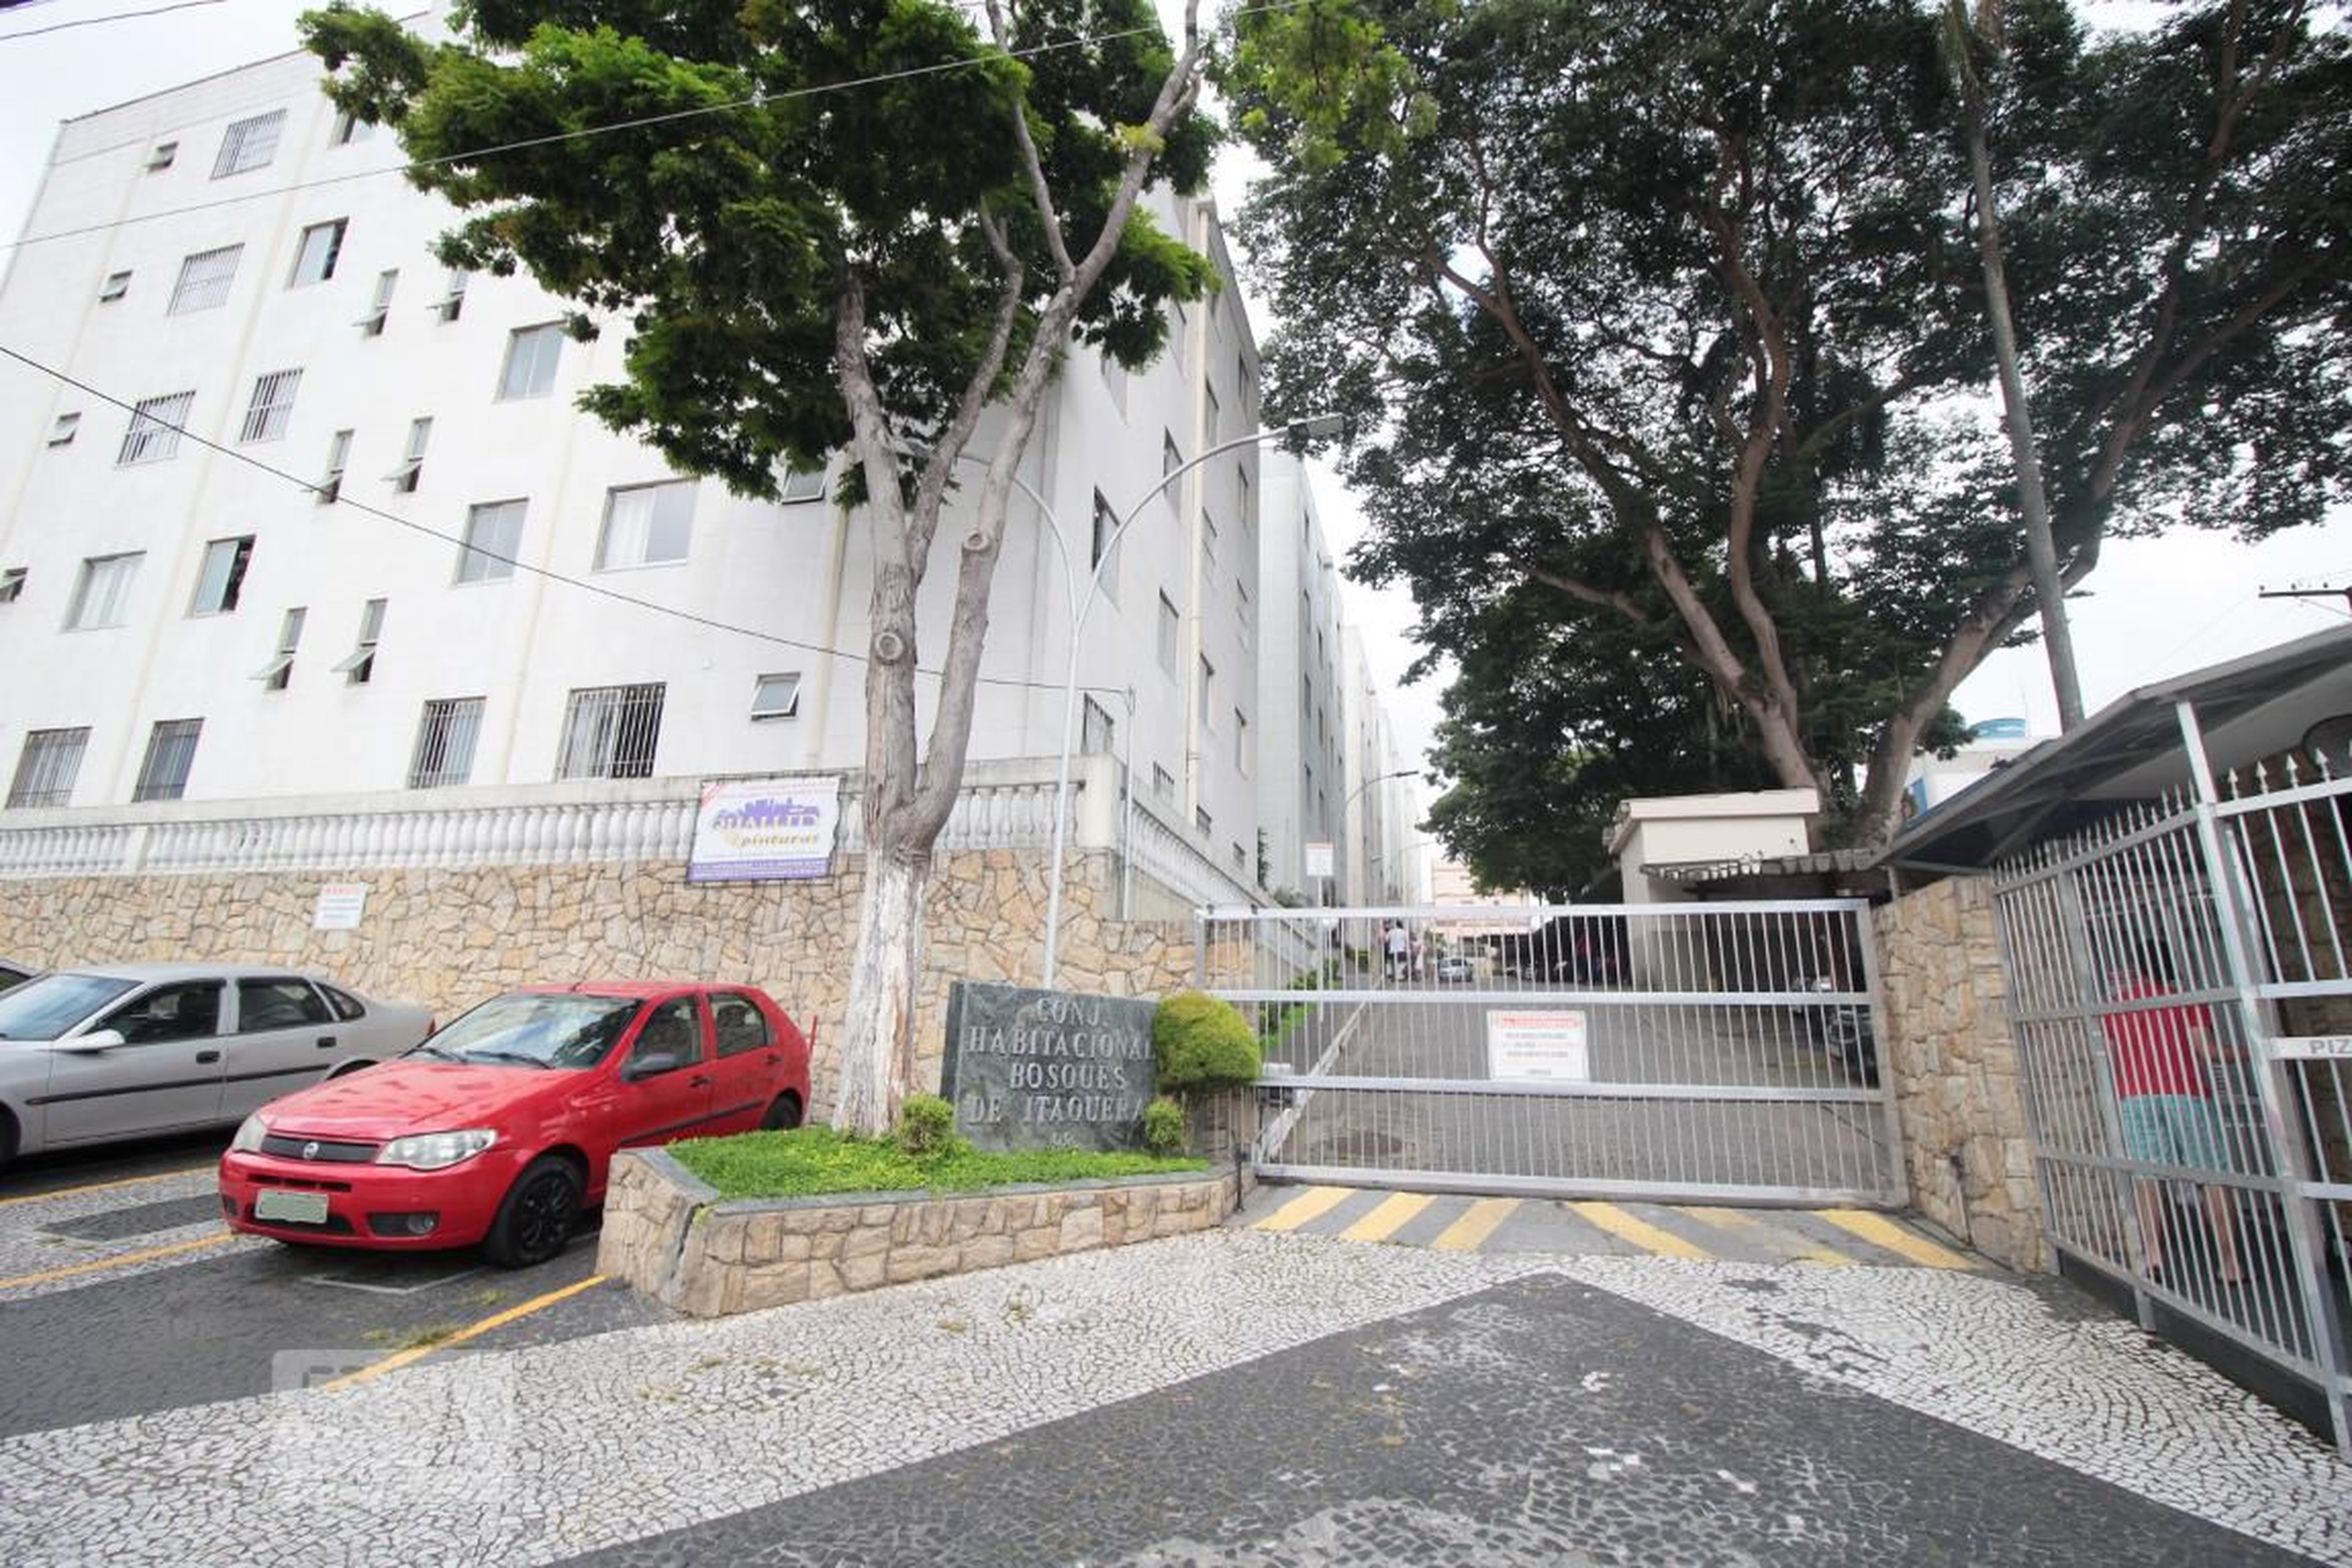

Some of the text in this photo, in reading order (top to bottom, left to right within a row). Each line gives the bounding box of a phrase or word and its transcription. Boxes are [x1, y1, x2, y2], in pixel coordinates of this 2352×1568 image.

[967, 1025, 1157, 1060] HABITACIONAL
[1009, 1061, 1126, 1090] BOSQUES
[967, 1095, 1003, 1123] DE
